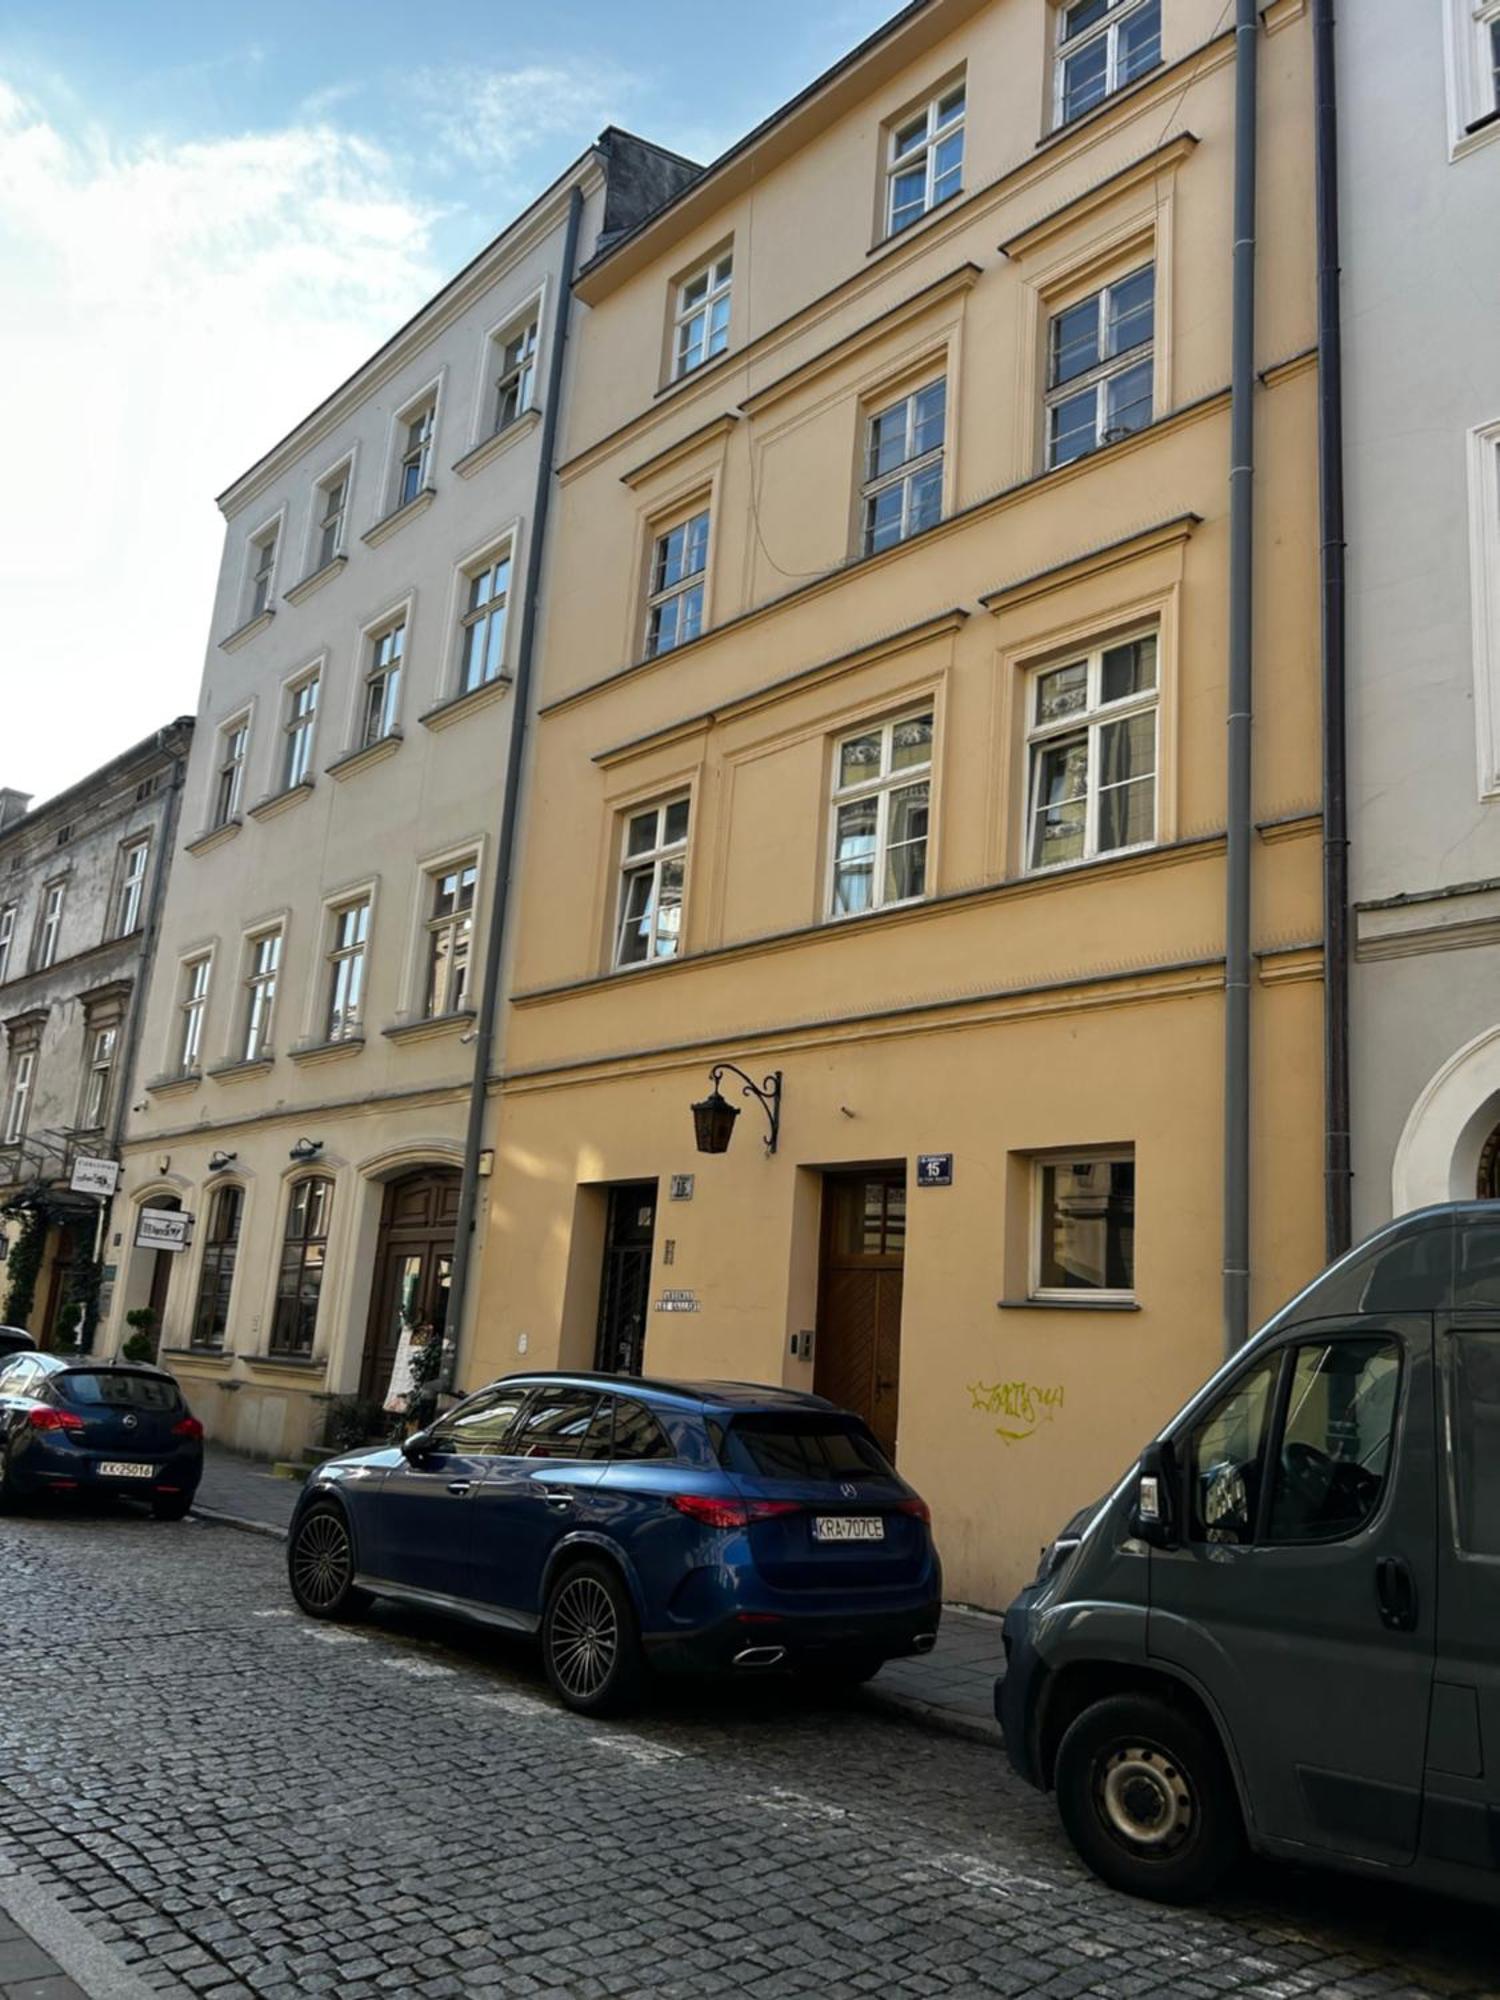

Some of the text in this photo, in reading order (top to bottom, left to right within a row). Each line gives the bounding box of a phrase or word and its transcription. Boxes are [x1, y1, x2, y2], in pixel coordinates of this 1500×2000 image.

[926, 1162, 940, 1177] 15
[819, 1519, 882, 1537] KRA 707CE
